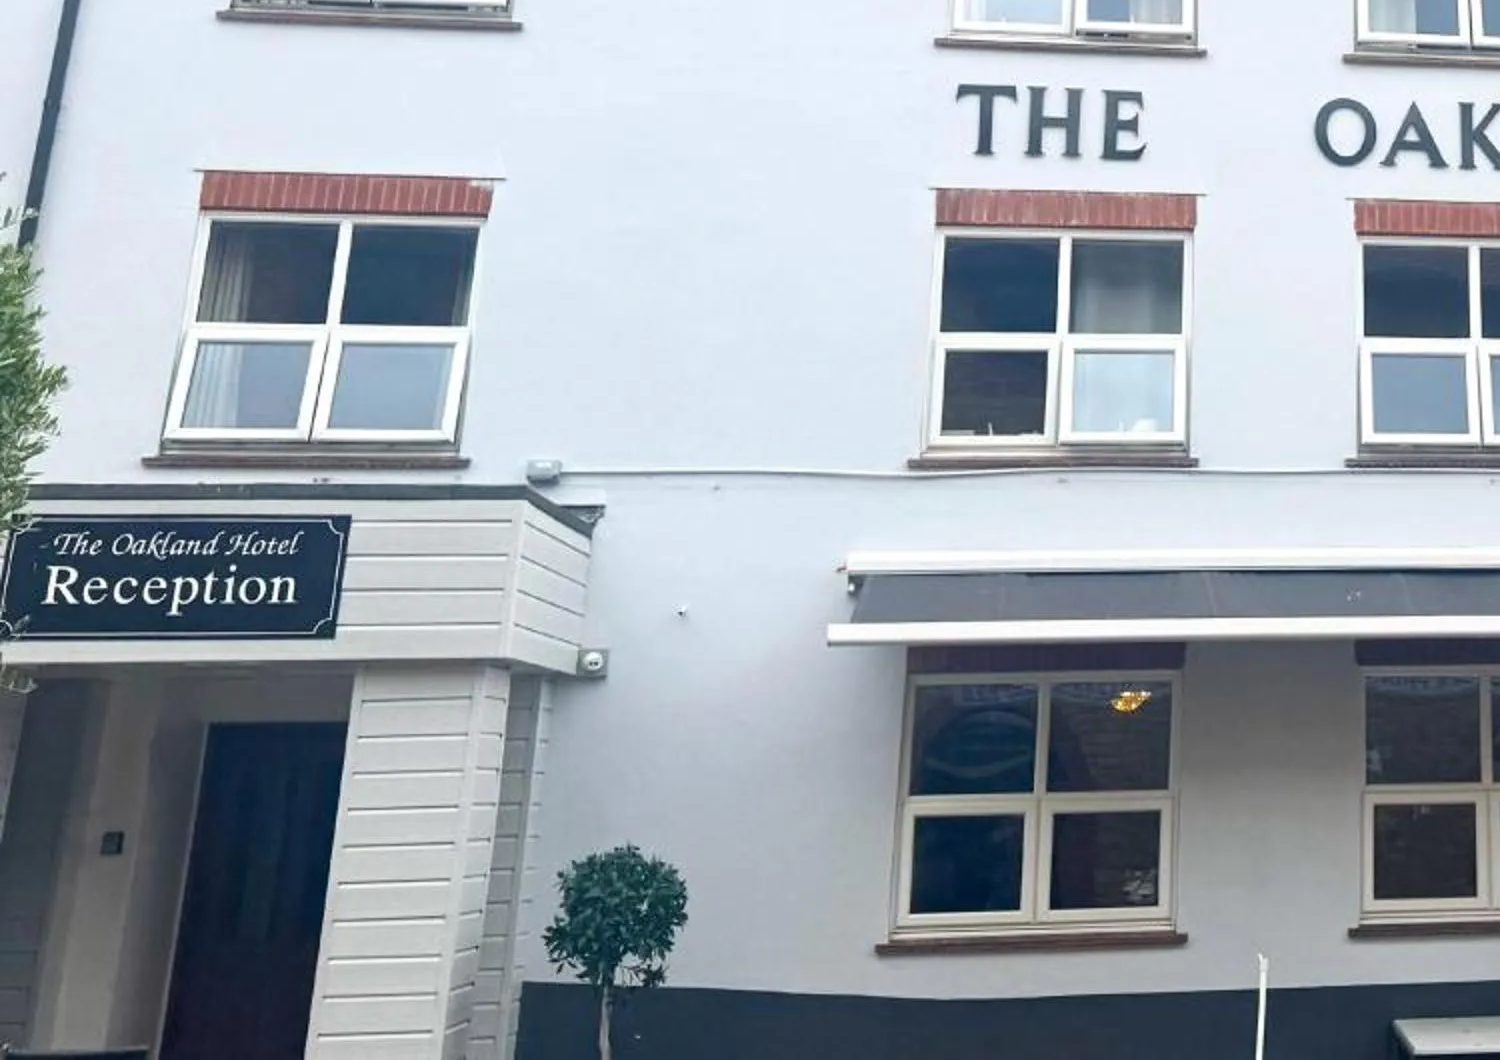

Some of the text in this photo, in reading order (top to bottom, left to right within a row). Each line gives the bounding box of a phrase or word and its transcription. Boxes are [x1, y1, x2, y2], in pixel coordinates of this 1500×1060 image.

[955, 83, 1148, 162] THE
[53, 531, 305, 561] The Oakland Hotel
[40, 564, 298, 617] Reception
